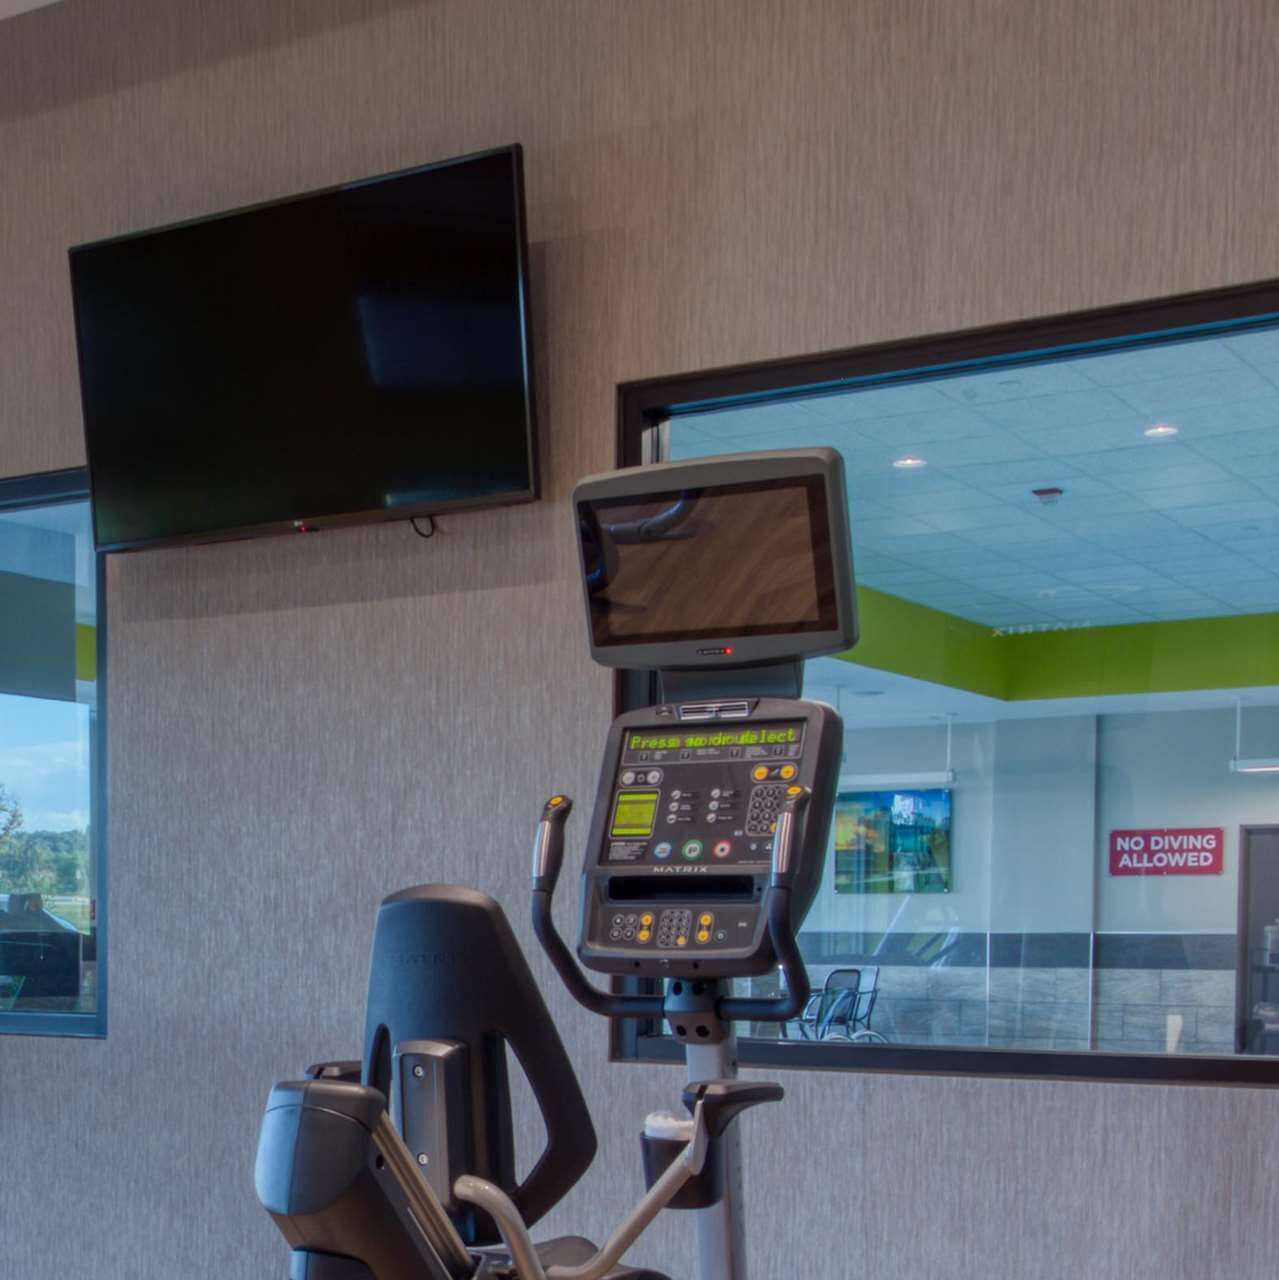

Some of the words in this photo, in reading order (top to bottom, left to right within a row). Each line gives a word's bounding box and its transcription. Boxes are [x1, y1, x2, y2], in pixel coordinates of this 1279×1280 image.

[1116, 836, 1145, 851] NO
[1150, 834, 1217, 850] DIVING
[1118, 851, 1214, 868] ALLOWED
[653, 865, 709, 873] MATRIX
